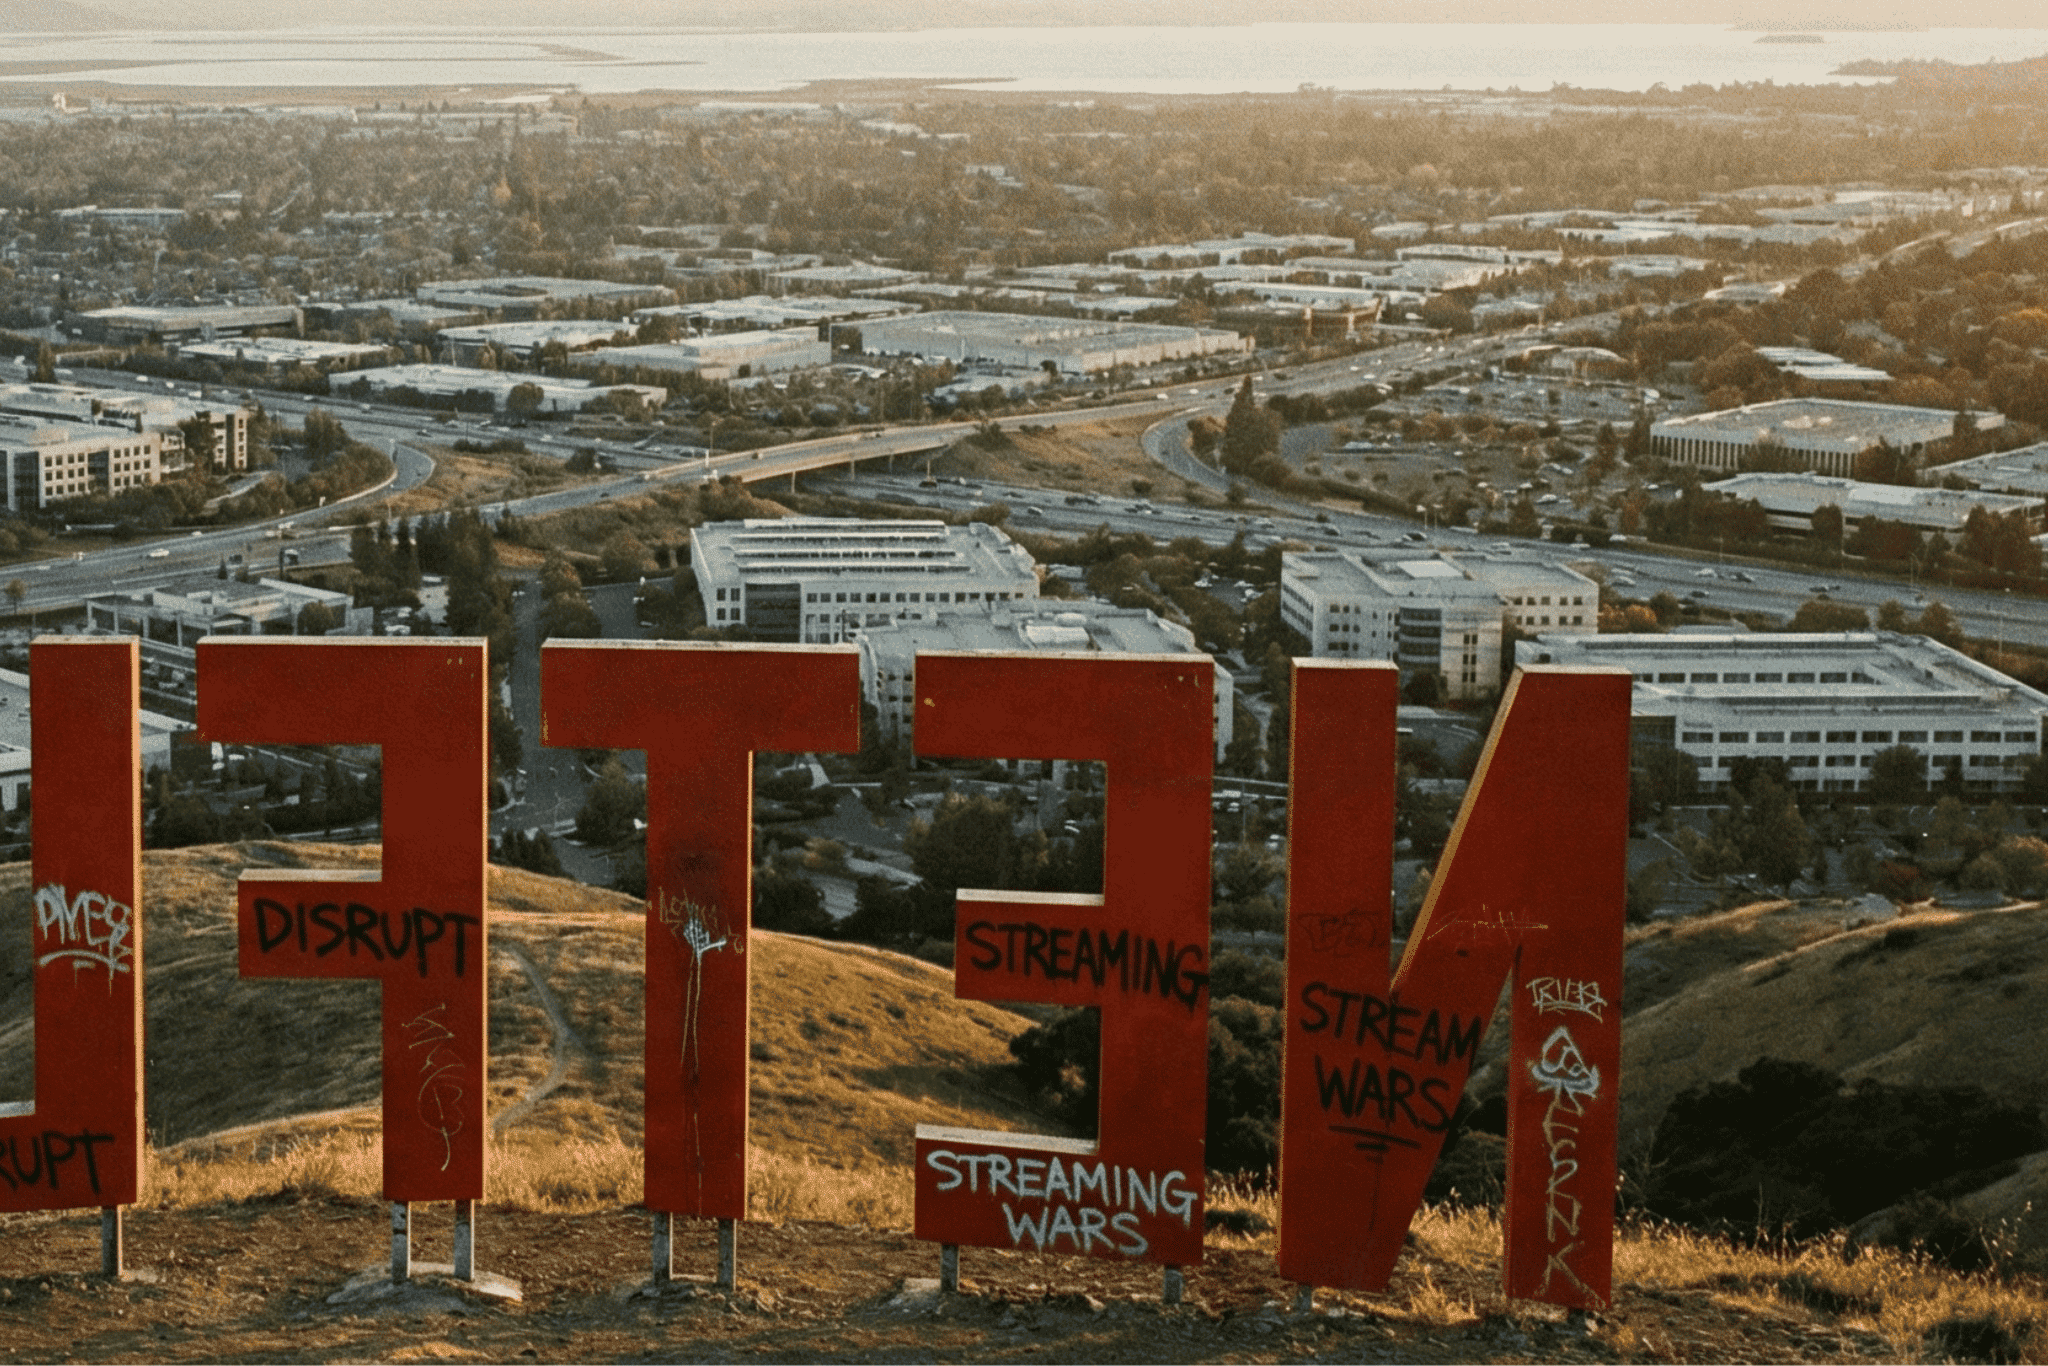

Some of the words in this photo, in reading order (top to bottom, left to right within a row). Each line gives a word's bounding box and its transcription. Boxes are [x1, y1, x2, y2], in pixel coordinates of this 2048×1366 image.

[253, 897, 480, 979] DISRUPT
[966, 921, 1210, 1012] STREAMING
[1301, 981, 1482, 1065] STREAM
[1314, 1054, 1451, 1134] WARS
[927, 1150, 1198, 1227] STREAMING
[1002, 1202, 1149, 1255] WARS
